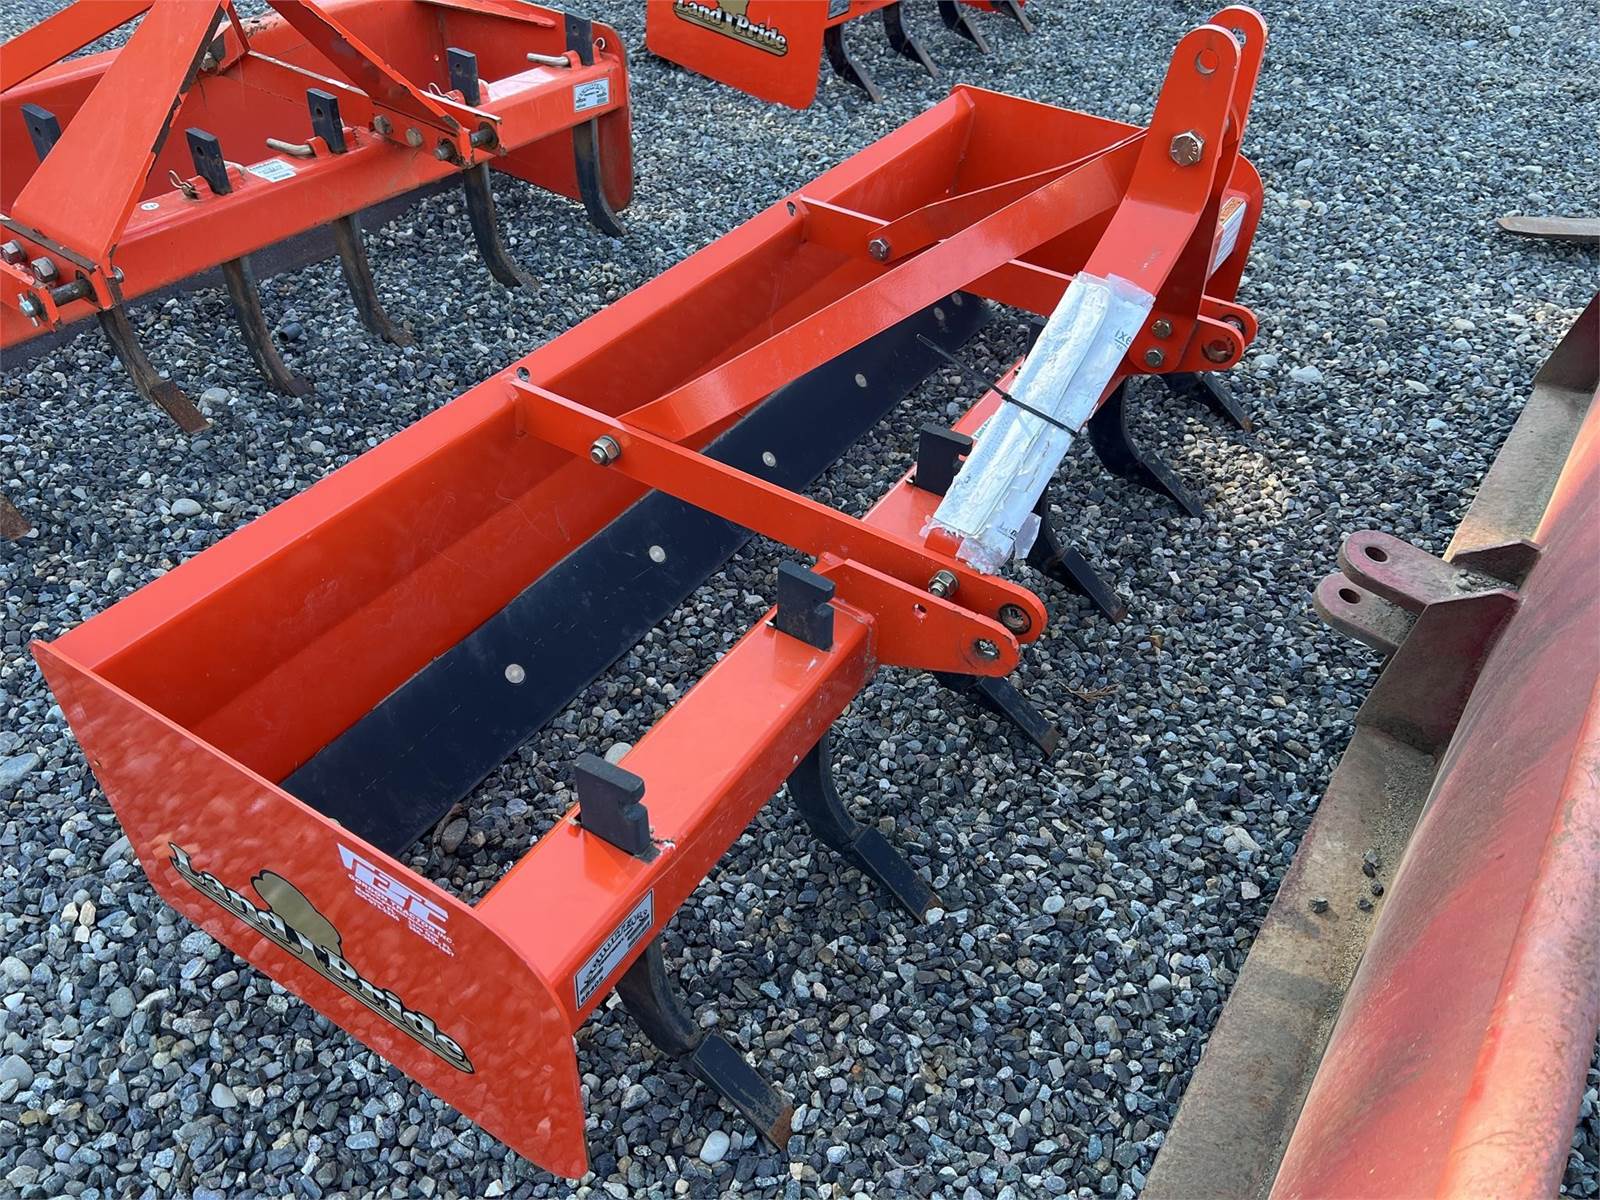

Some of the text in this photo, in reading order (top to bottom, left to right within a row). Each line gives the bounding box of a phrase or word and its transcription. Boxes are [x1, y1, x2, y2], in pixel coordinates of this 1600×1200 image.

[674, 0, 788, 49] Land Pride
[168, 842, 293, 945] Land
[321, 945, 466, 1062] Pride
